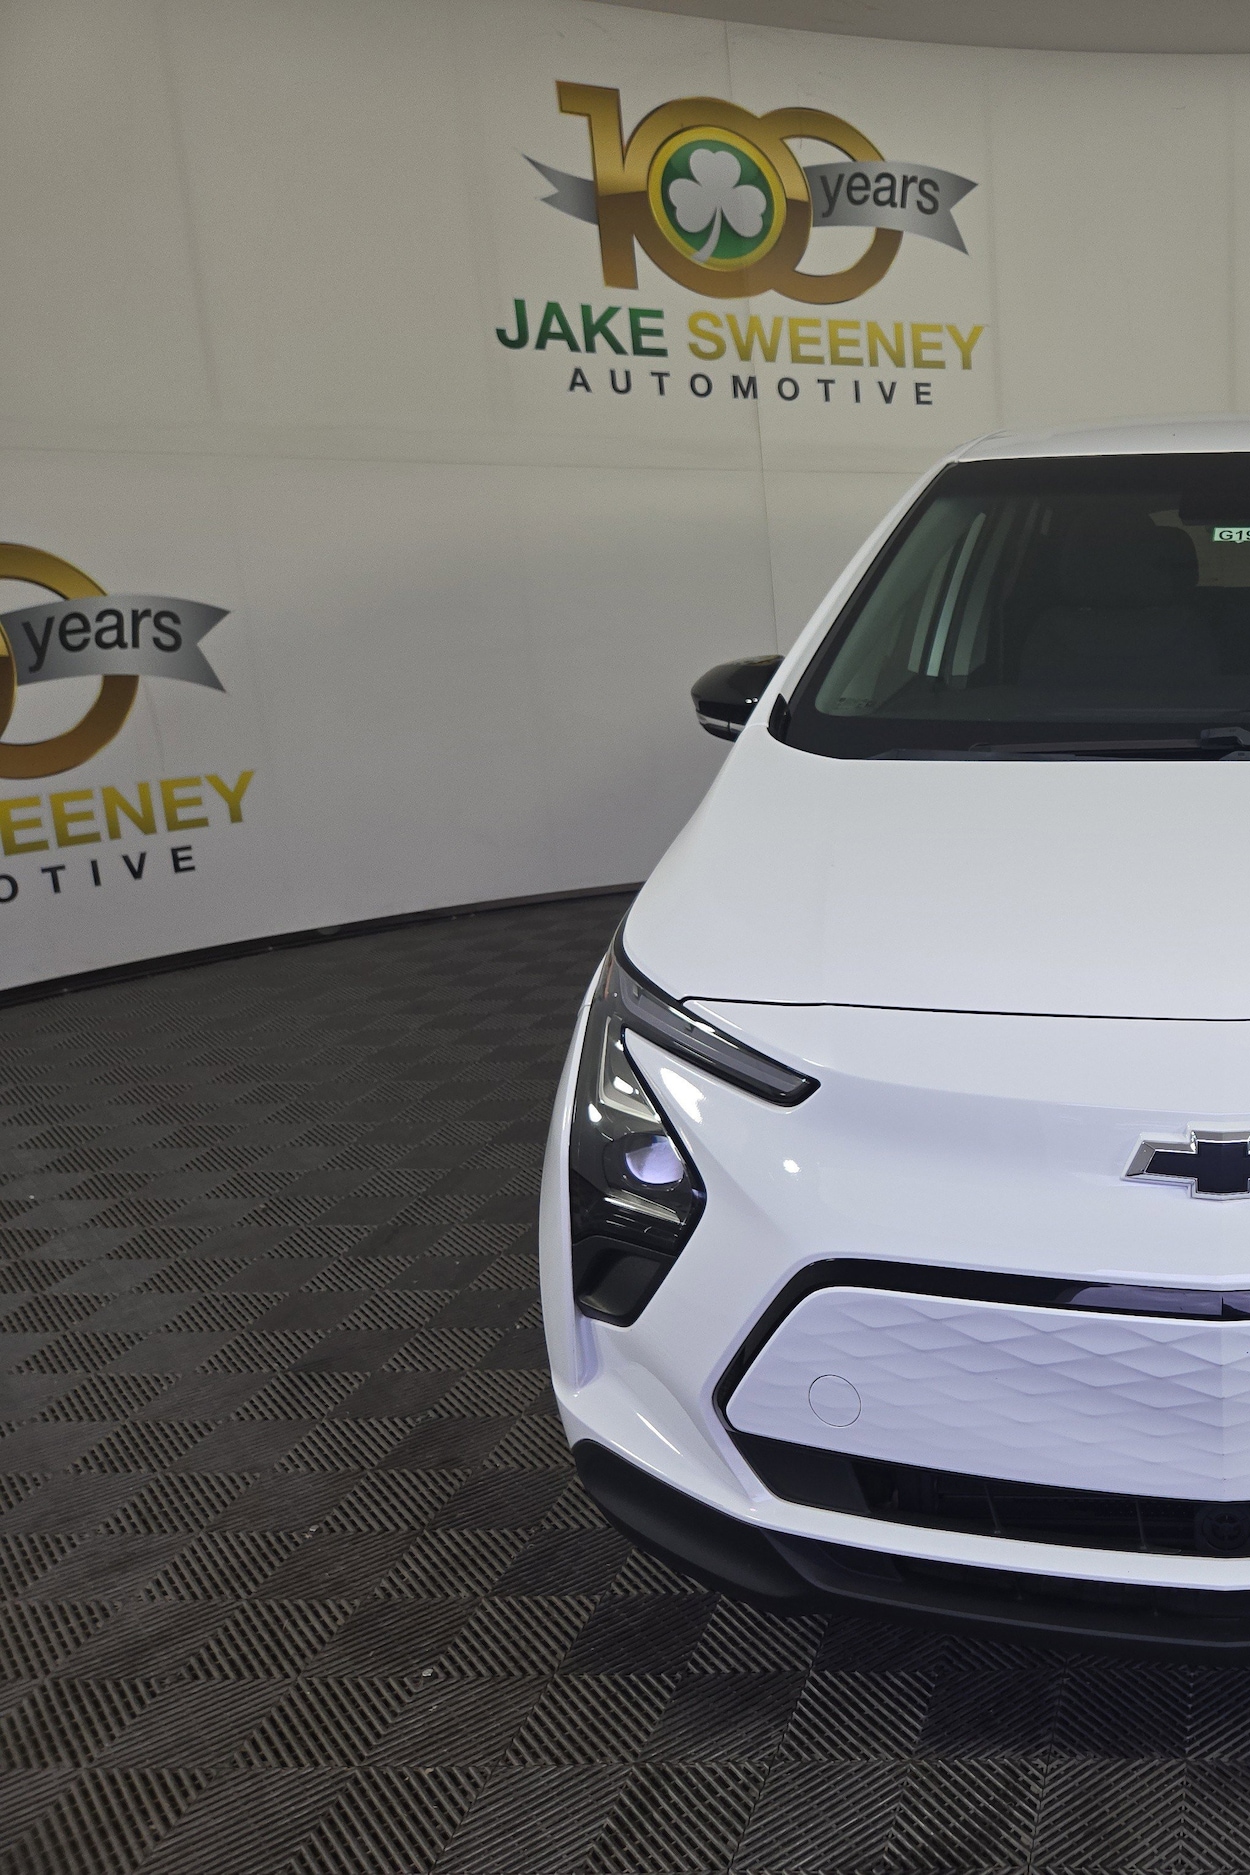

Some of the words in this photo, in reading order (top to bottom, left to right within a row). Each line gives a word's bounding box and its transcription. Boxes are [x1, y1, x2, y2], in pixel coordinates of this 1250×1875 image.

[555, 80, 904, 305] 100
[819, 168, 941, 217] years
[495, 298, 669, 358] JAKE
[687, 310, 985, 371] SWEENEY
[568, 367, 934, 405] AUTOMOTIVE
[22, 607, 183, 673] years
